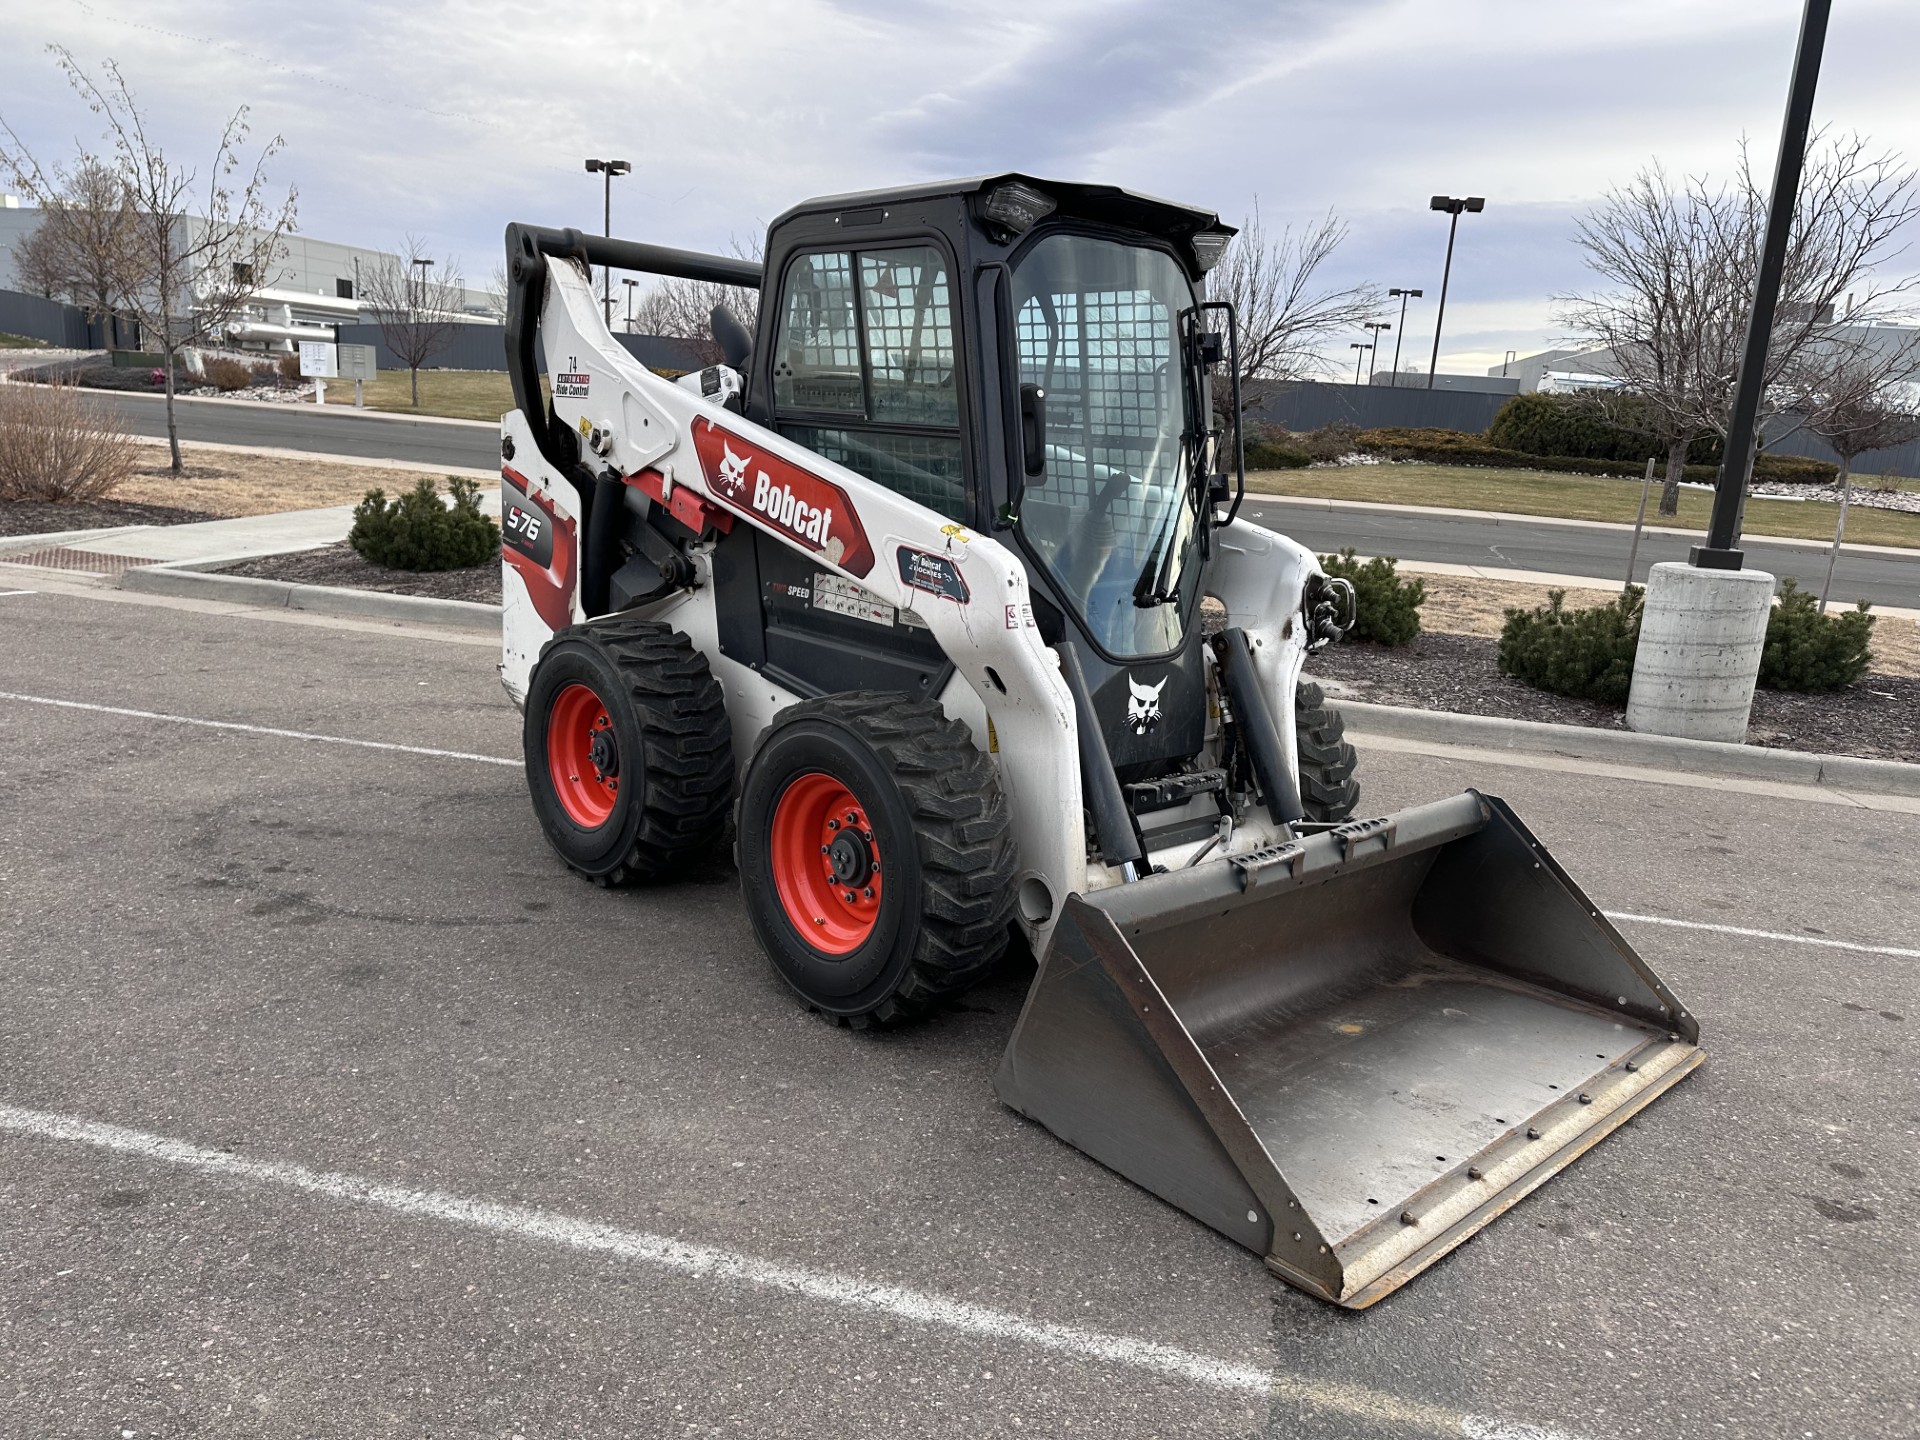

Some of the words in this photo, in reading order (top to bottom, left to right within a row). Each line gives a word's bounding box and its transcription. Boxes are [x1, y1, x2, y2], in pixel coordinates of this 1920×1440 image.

[568, 356, 577, 373] 74
[556, 384, 568, 395] Ride
[569, 384, 589, 396] Control
[753, 469, 832, 548] Bobcat
[507, 506, 541, 541] S76
[921, 557, 942, 571] Bcat
[772, 582, 787, 593] TWO
[787, 585, 810, 599] SPEED
